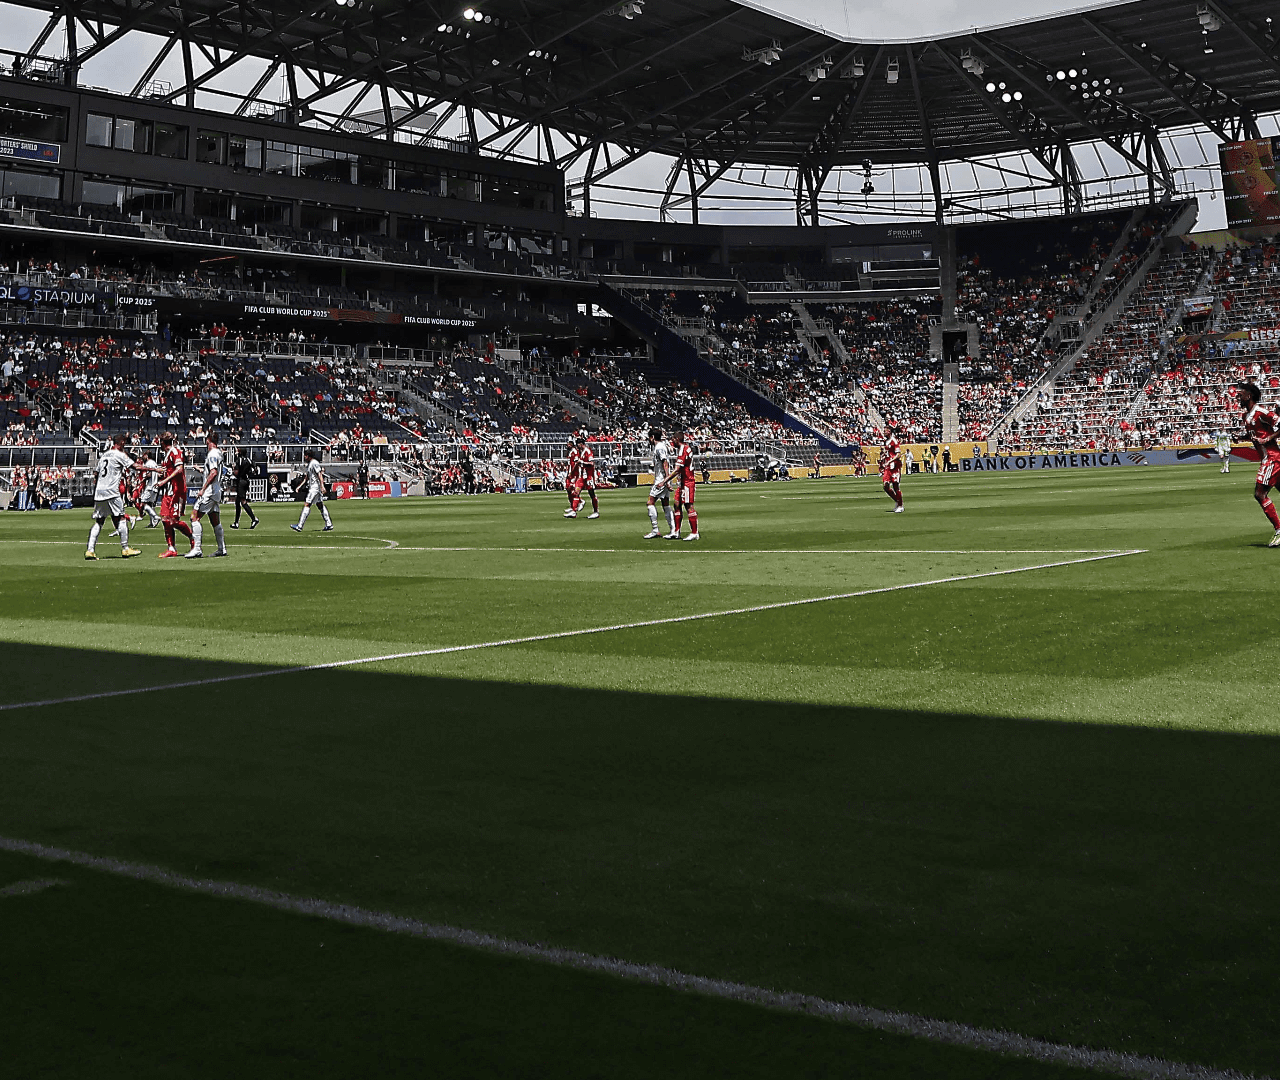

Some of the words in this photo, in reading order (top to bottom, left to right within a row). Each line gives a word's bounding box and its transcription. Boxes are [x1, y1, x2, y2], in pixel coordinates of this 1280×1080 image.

[34, 290, 95, 304] STADIUM
[119, 296, 134, 305] CUP
[276, 308, 299, 316] WORLD
[300, 309, 312, 317] CUP
[101, 459, 109, 478] 3
[963, 457, 1010, 471] BANK
[1015, 456, 1037, 470] OF
[1041, 453, 1122, 469] AMERICA
